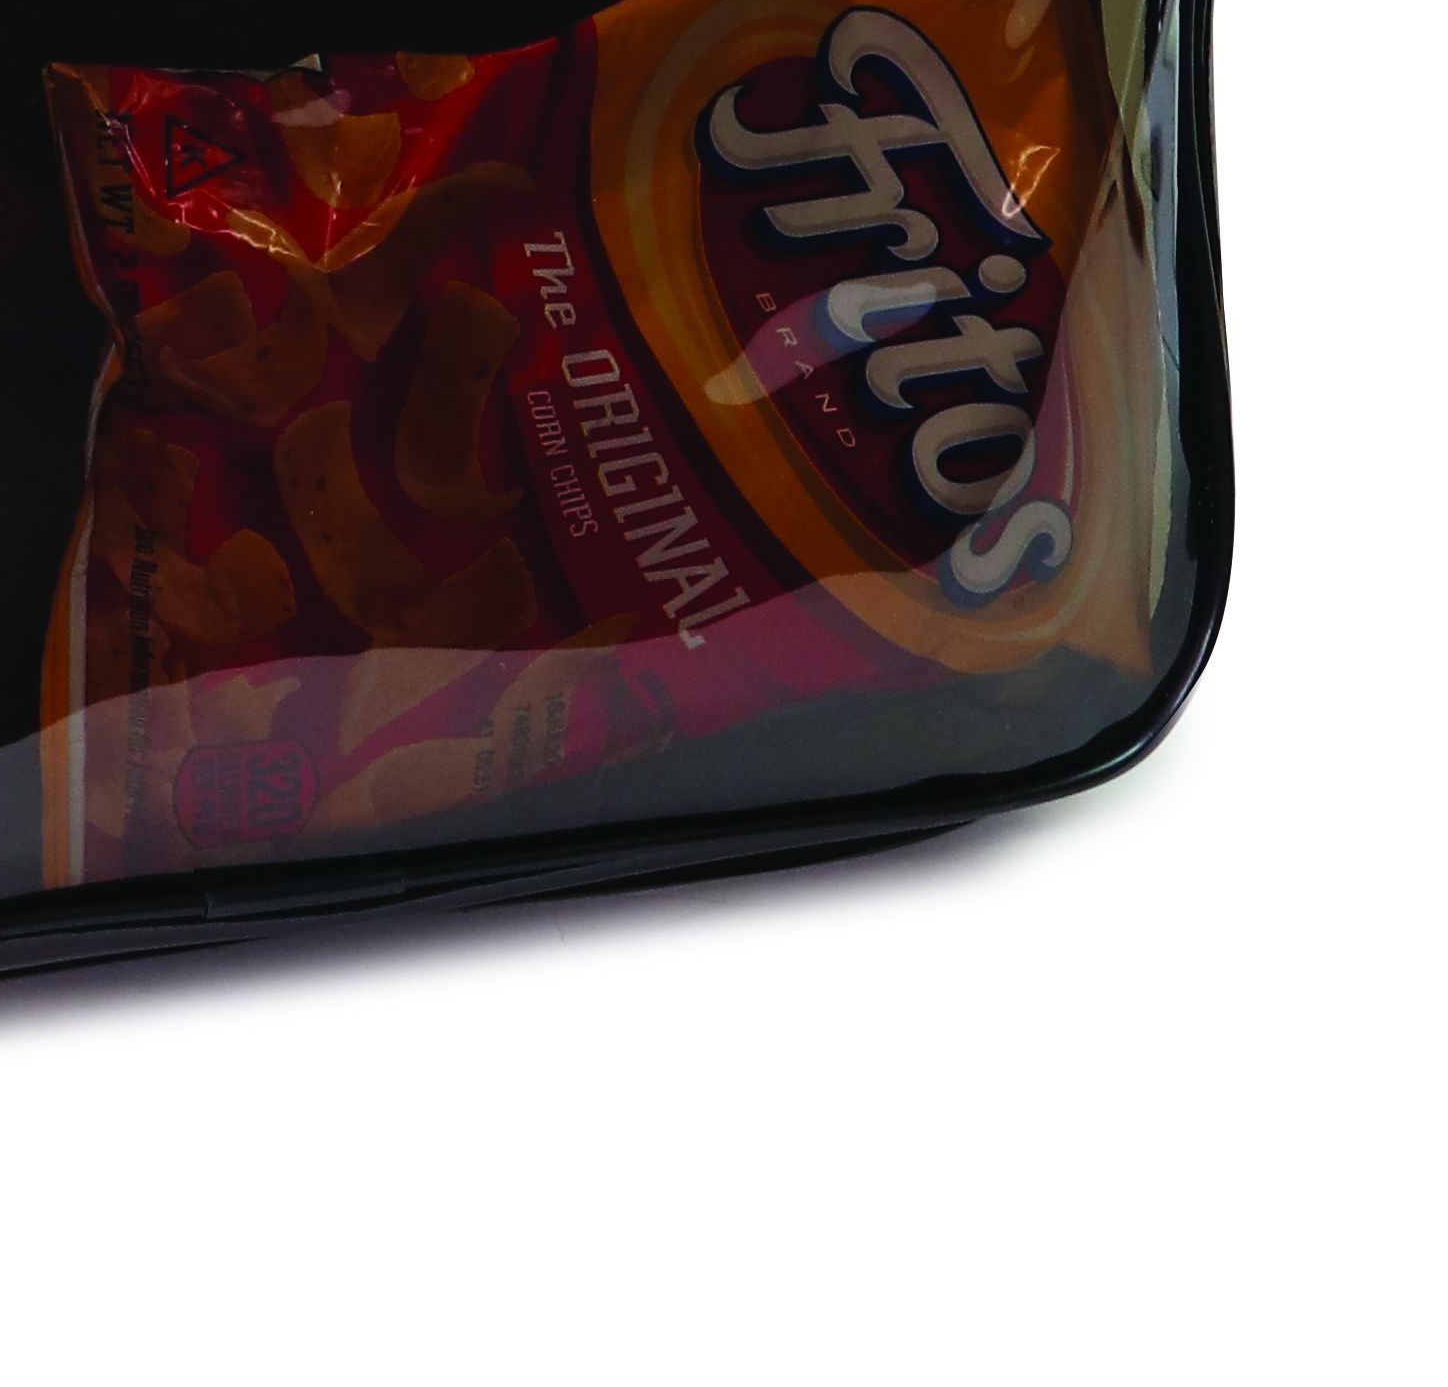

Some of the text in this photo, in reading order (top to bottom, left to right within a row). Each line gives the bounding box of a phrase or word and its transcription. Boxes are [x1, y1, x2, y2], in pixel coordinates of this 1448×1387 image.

[99, 184, 135, 235] WT
[708, 6, 1074, 595] Fritos
[755, 290, 857, 450] BRAND
[522, 230, 578, 331] The
[560, 348, 753, 651] ORIGINAL
[526, 389, 600, 539] CORN CHIPS
[245, 751, 301, 829] 320
